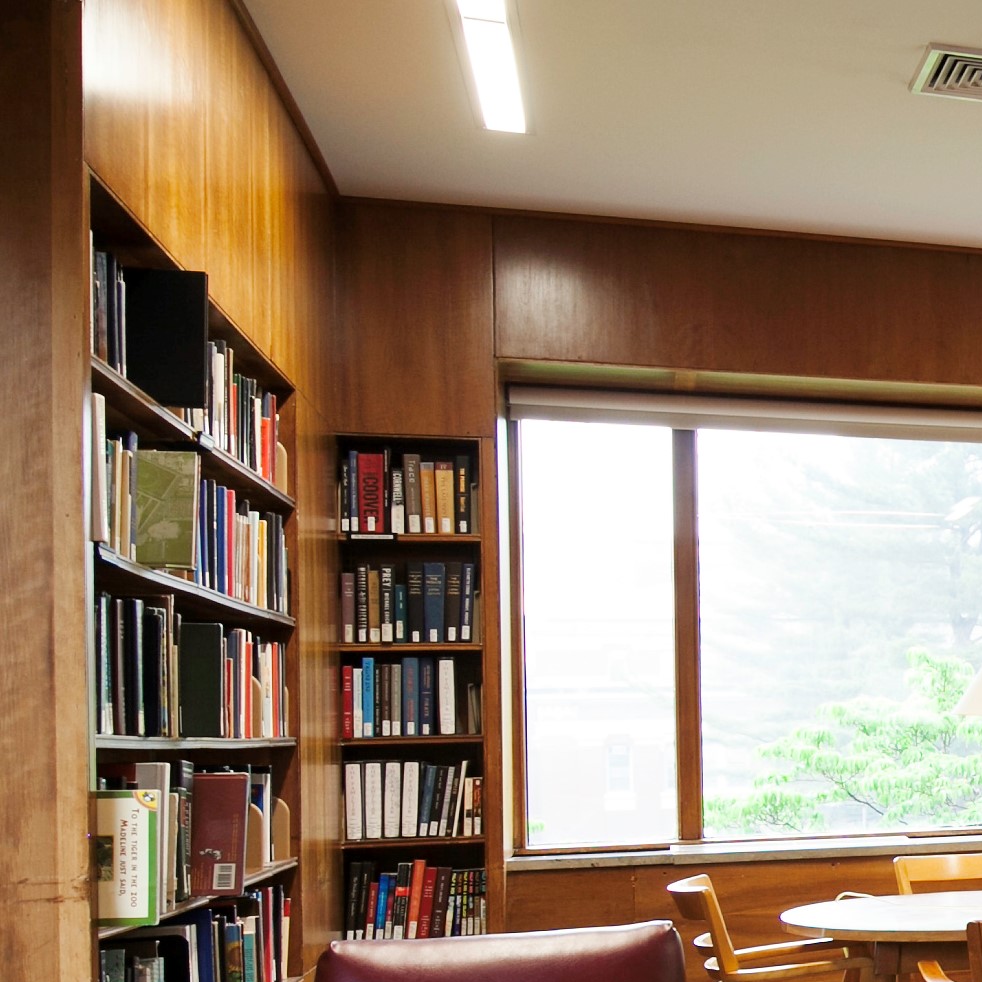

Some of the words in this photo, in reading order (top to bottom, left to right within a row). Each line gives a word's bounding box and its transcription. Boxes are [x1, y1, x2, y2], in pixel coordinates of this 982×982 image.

[382, 567, 392, 587] PREY
[131, 809, 140, 820] TO
[119, 819, 129, 857] MADELINE
[119, 860, 127, 875] JUST
[131, 864, 138, 872] IN
[118, 878, 127, 897] SAID,
[130, 892, 138, 908] ZOO
